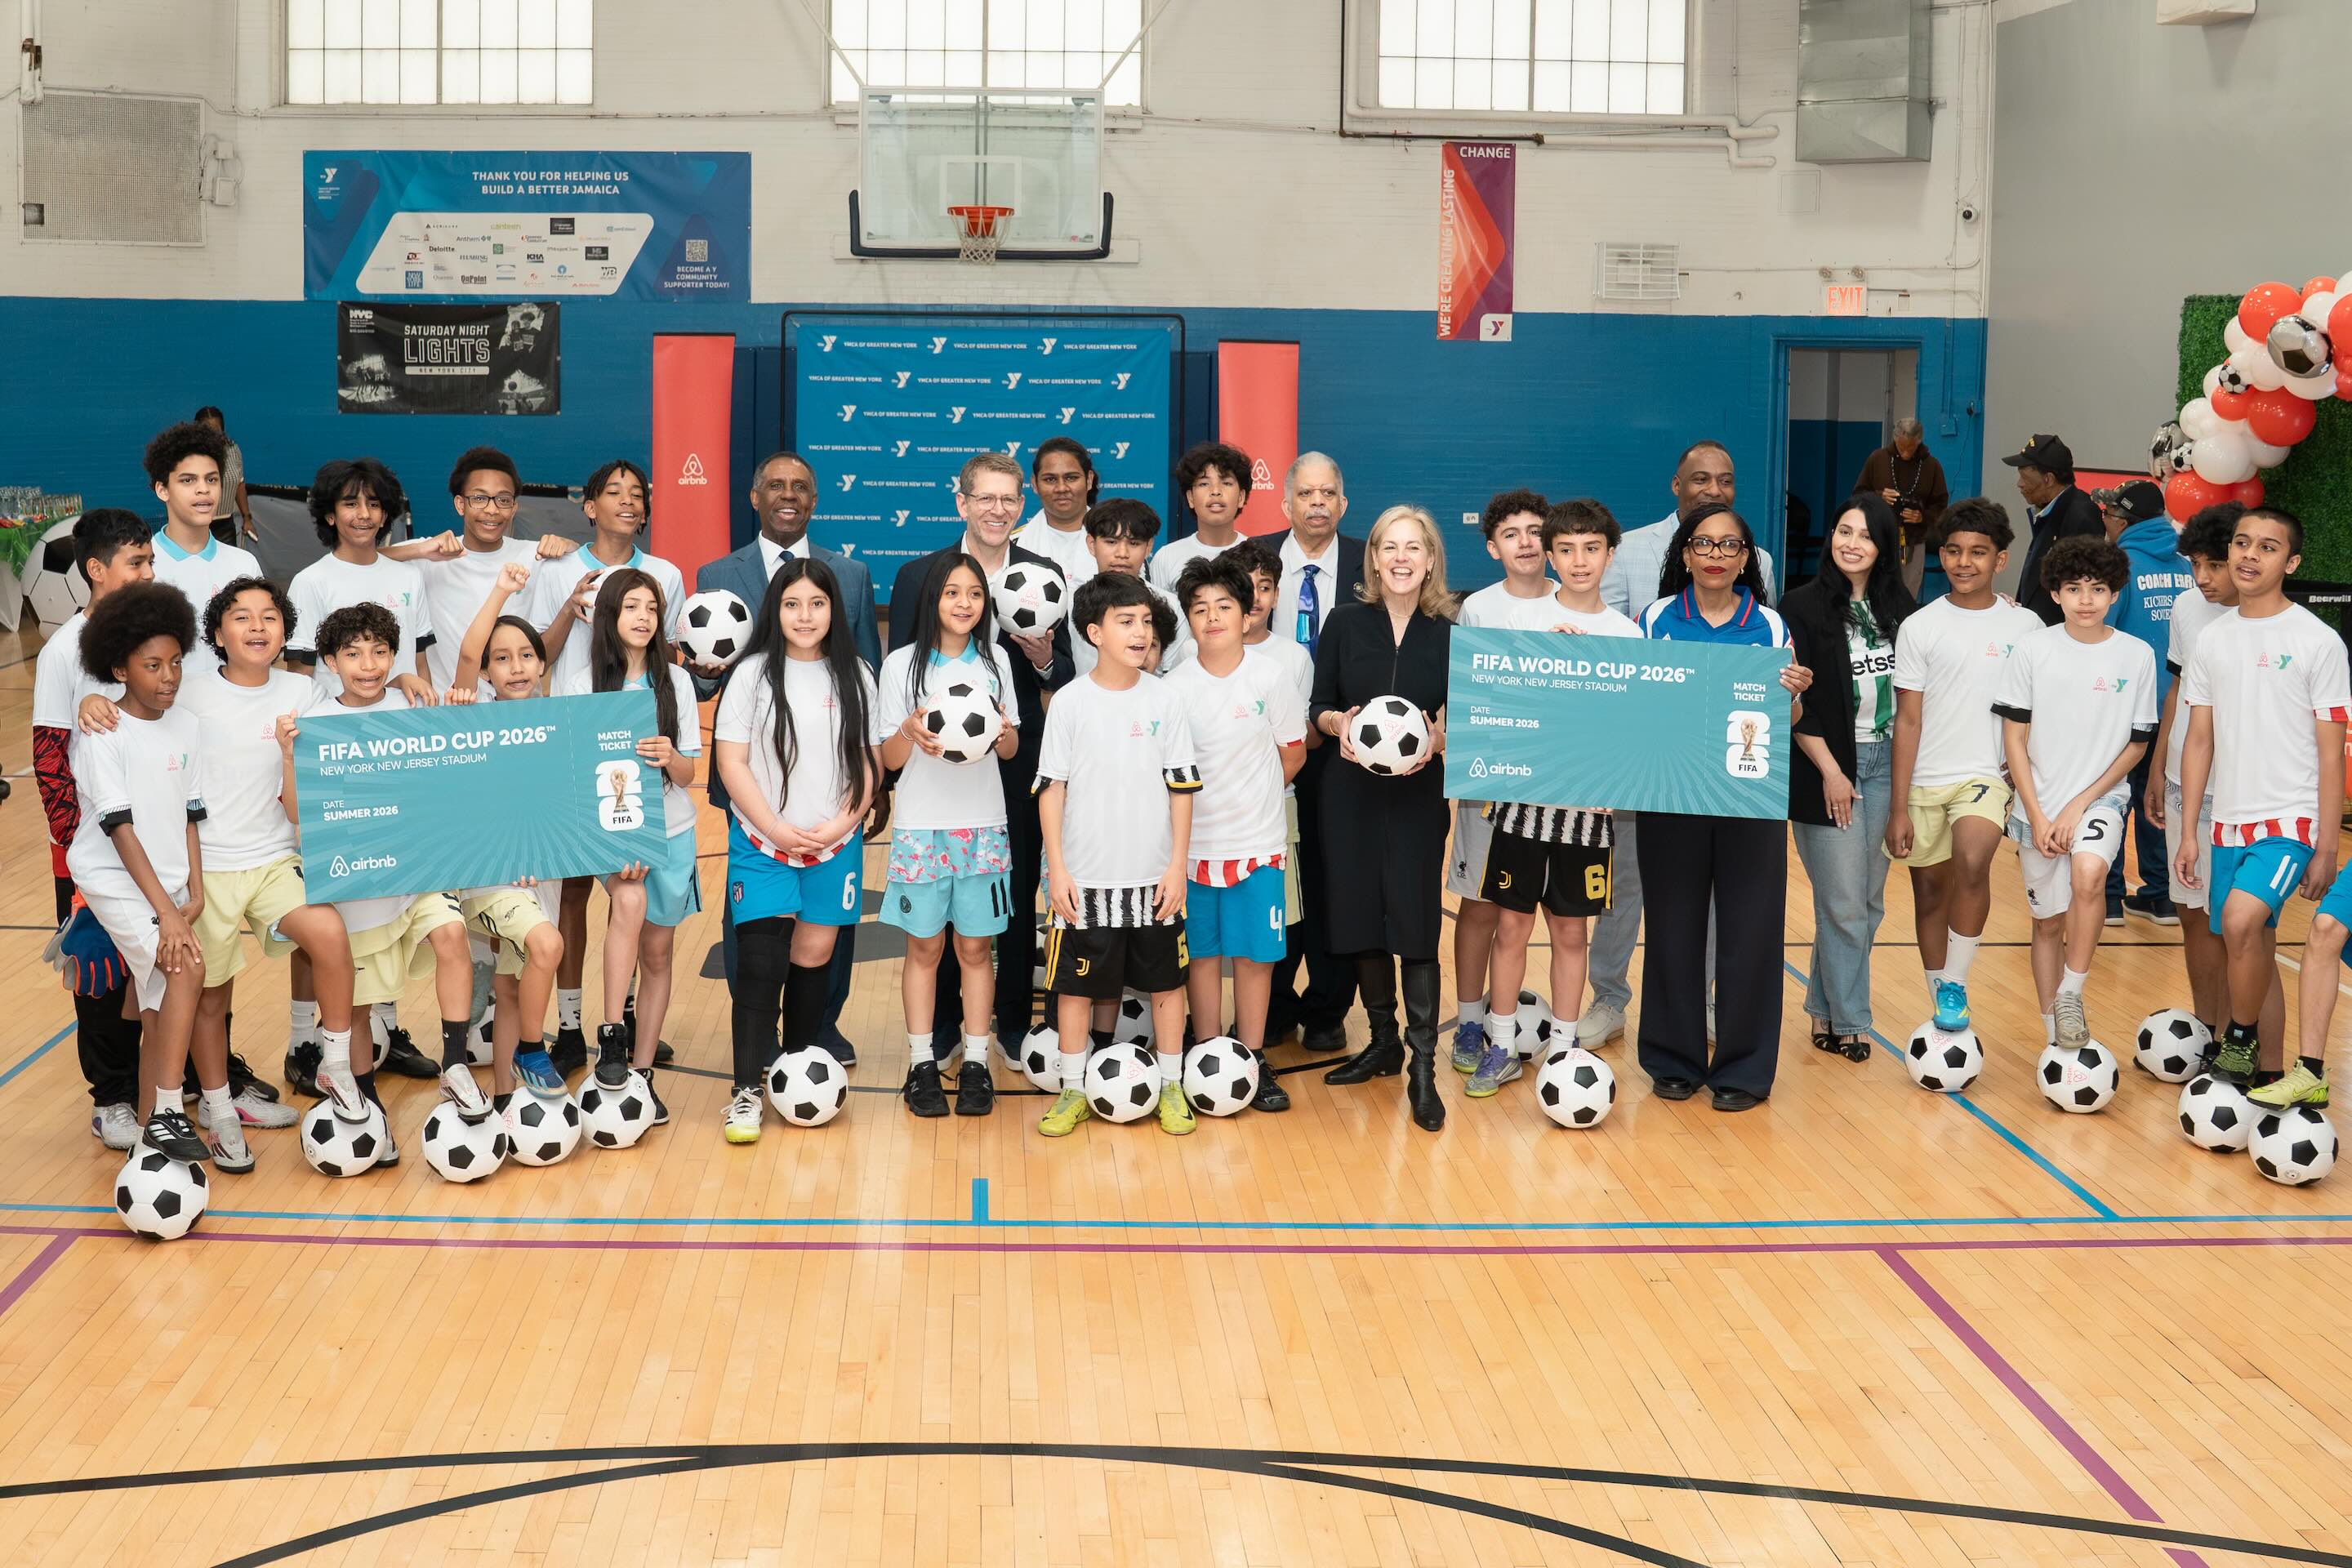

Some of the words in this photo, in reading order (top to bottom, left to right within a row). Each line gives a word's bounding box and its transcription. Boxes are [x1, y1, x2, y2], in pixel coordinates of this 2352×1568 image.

[1459, 145, 1511, 158] CHANGE
[472, 172, 510, 181] THANK
[514, 172, 537, 181] YOU
[540, 172, 561, 181] FOR
[564, 172, 611, 181] HELPING
[614, 172, 629, 181] US
[482, 185, 514, 194] BUILD
[517, 185, 525, 194] A
[528, 185, 569, 194] BETTER
[572, 185, 620, 194] JAMAICA
[1442, 169, 1455, 225] LASTING
[1441, 227, 1454, 293] CREATING
[1827, 287, 1863, 314] EXIT
[350, 310, 373, 319] NYC
[1440, 295, 1452, 337] WE'RE
[404, 325, 456, 336] SATURDAY
[459, 325, 490, 336] NIGHT
[404, 338, 490, 363] LIGHTS
[679, 475, 707, 485] airbnb
[1252, 480, 1274, 490] irbnb
[2137, 573, 2172, 590] COACH
[1472, 653, 1514, 671] FIFA
[1518, 657, 1591, 676] WORLD
[1596, 662, 1637, 679] CUP
[1472, 674, 1494, 684] NEW
[1497, 675, 1522, 686] YORK
[1525, 677, 1547, 688] NEW
[1549, 679, 1583, 690] JERSEY
[1584, 682, 1627, 693] STADIUM
[1733, 682, 1766, 692] MATCH
[1734, 692, 1766, 702] TICKET
[1470, 706, 1490, 714] DATE
[1470, 715, 1514, 727] SUMMER
[1515, 719, 1539, 728] 2026
[598, 730, 631, 741] MATCH
[318, 742, 364, 761] FIFA
[368, 734, 448, 758] WORLD
[452, 730, 495, 750] CUP
[599, 741, 632, 751] TICKET
[320, 765, 345, 776] NEW
[347, 762, 376, 775] YORK
[377, 760, 403, 772] NEW
[404, 756, 439, 769] JERSEY
[442, 752, 487, 765] STADIUM
[1489, 763, 1532, 777] airbnb
[1739, 764, 1757, 772] FIFA
[1971, 783, 1990, 803] 7
[323, 800, 345, 809] DATE
[323, 808, 371, 822] SUMMER
[372, 805, 399, 817] 2026
[612, 816, 632, 824] FIFA
[2082, 818, 2109, 841] 5
[350, 854, 397, 871] airbnb
[1584, 864, 1606, 900] 6
[2269, 854, 2298, 897] 11
[842, 871, 857, 911] 6
[991, 877, 1008, 918] 11
[1269, 905, 1283, 942] 4
